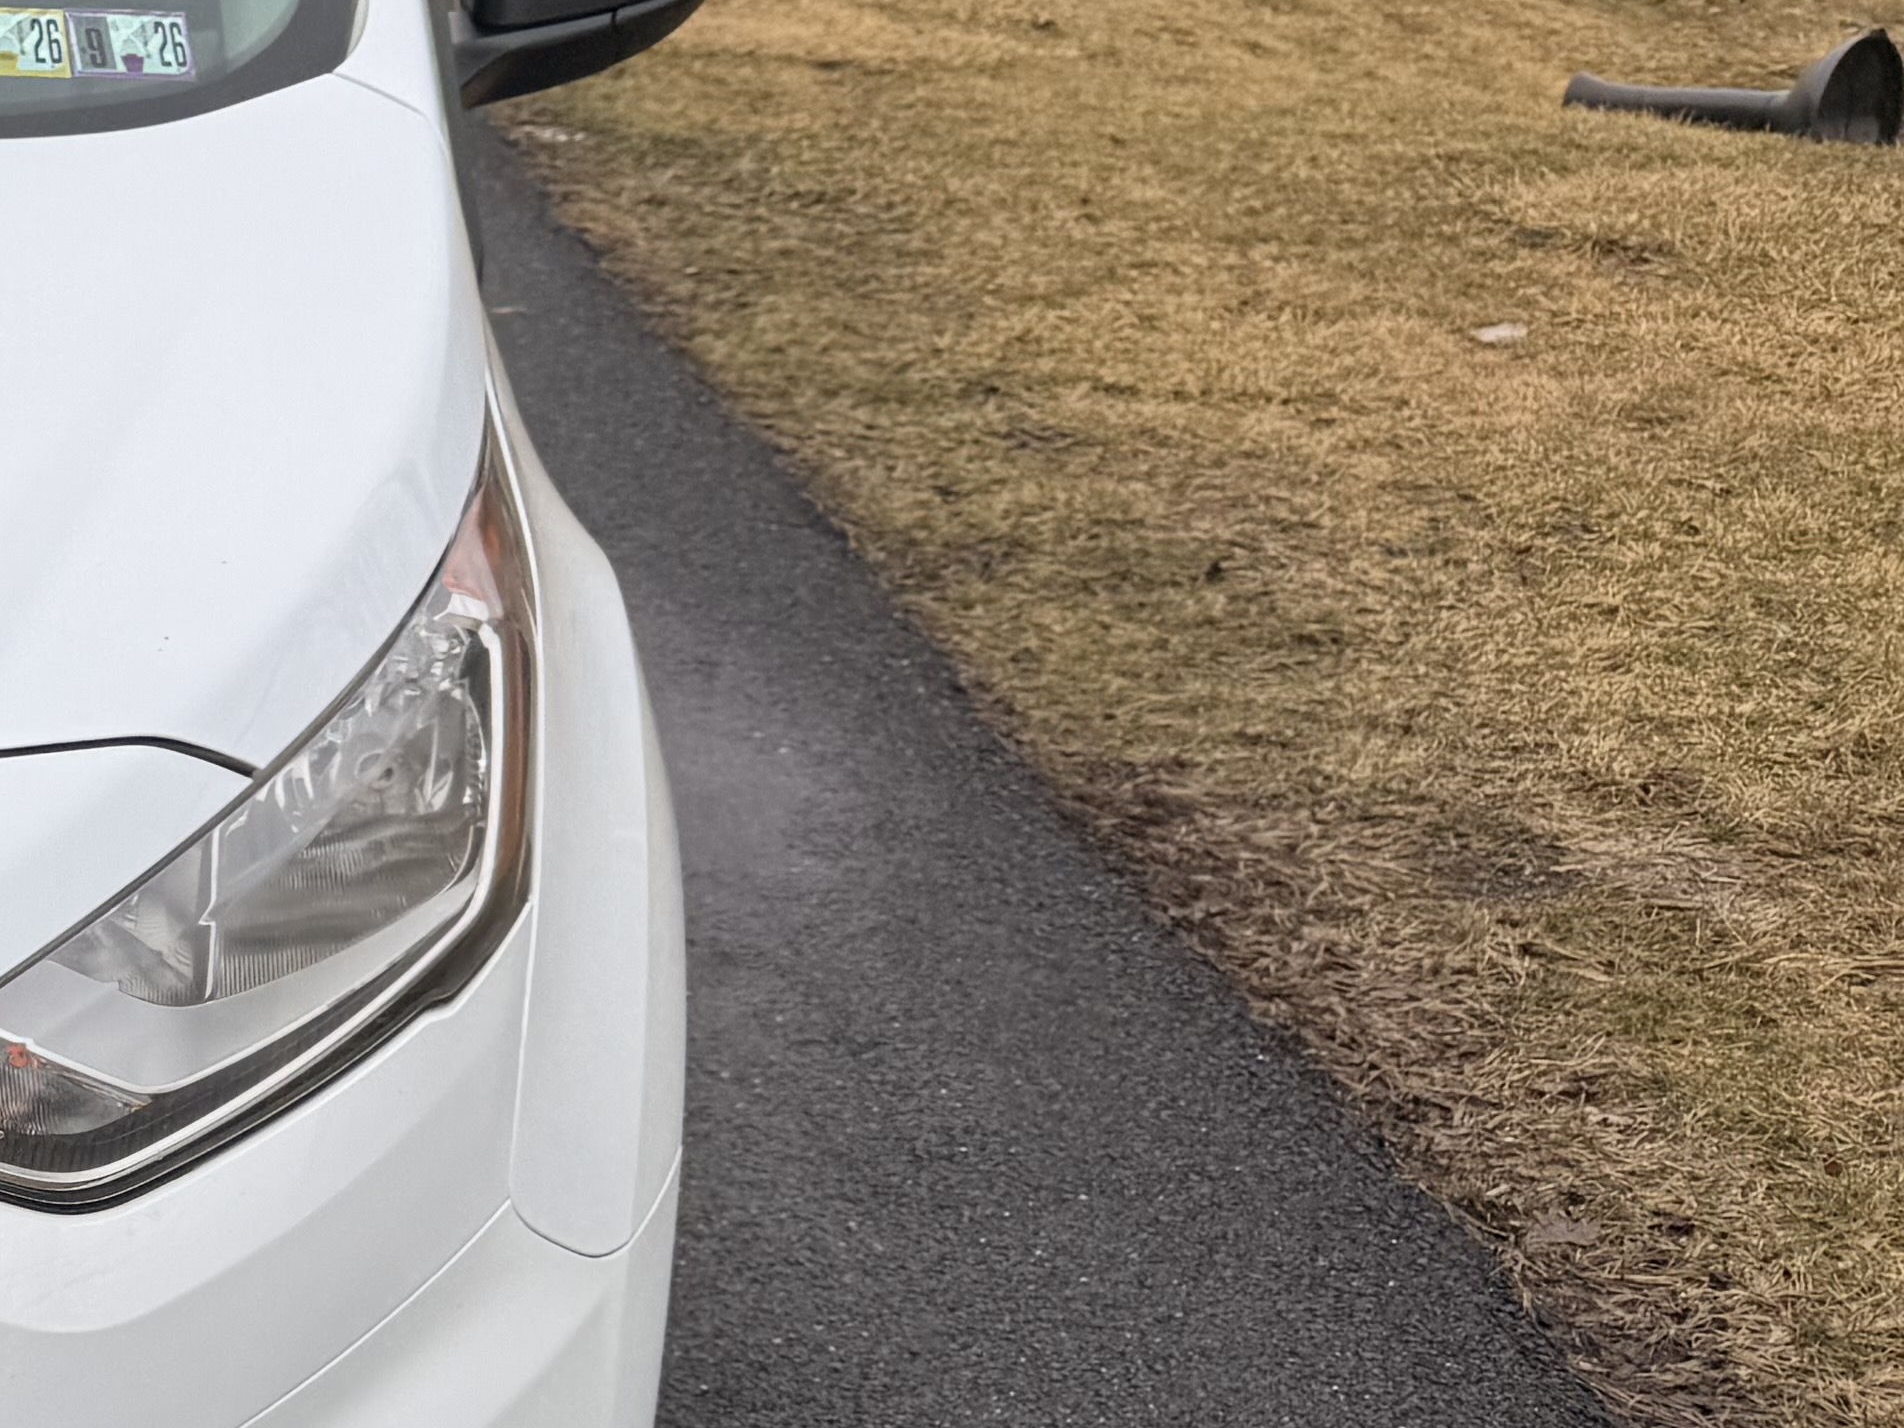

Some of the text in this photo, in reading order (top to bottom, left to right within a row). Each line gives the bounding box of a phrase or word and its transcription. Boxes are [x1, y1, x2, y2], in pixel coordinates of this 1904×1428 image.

[30, 18, 62, 64] 26
[85, 21, 187, 68] 9 26
